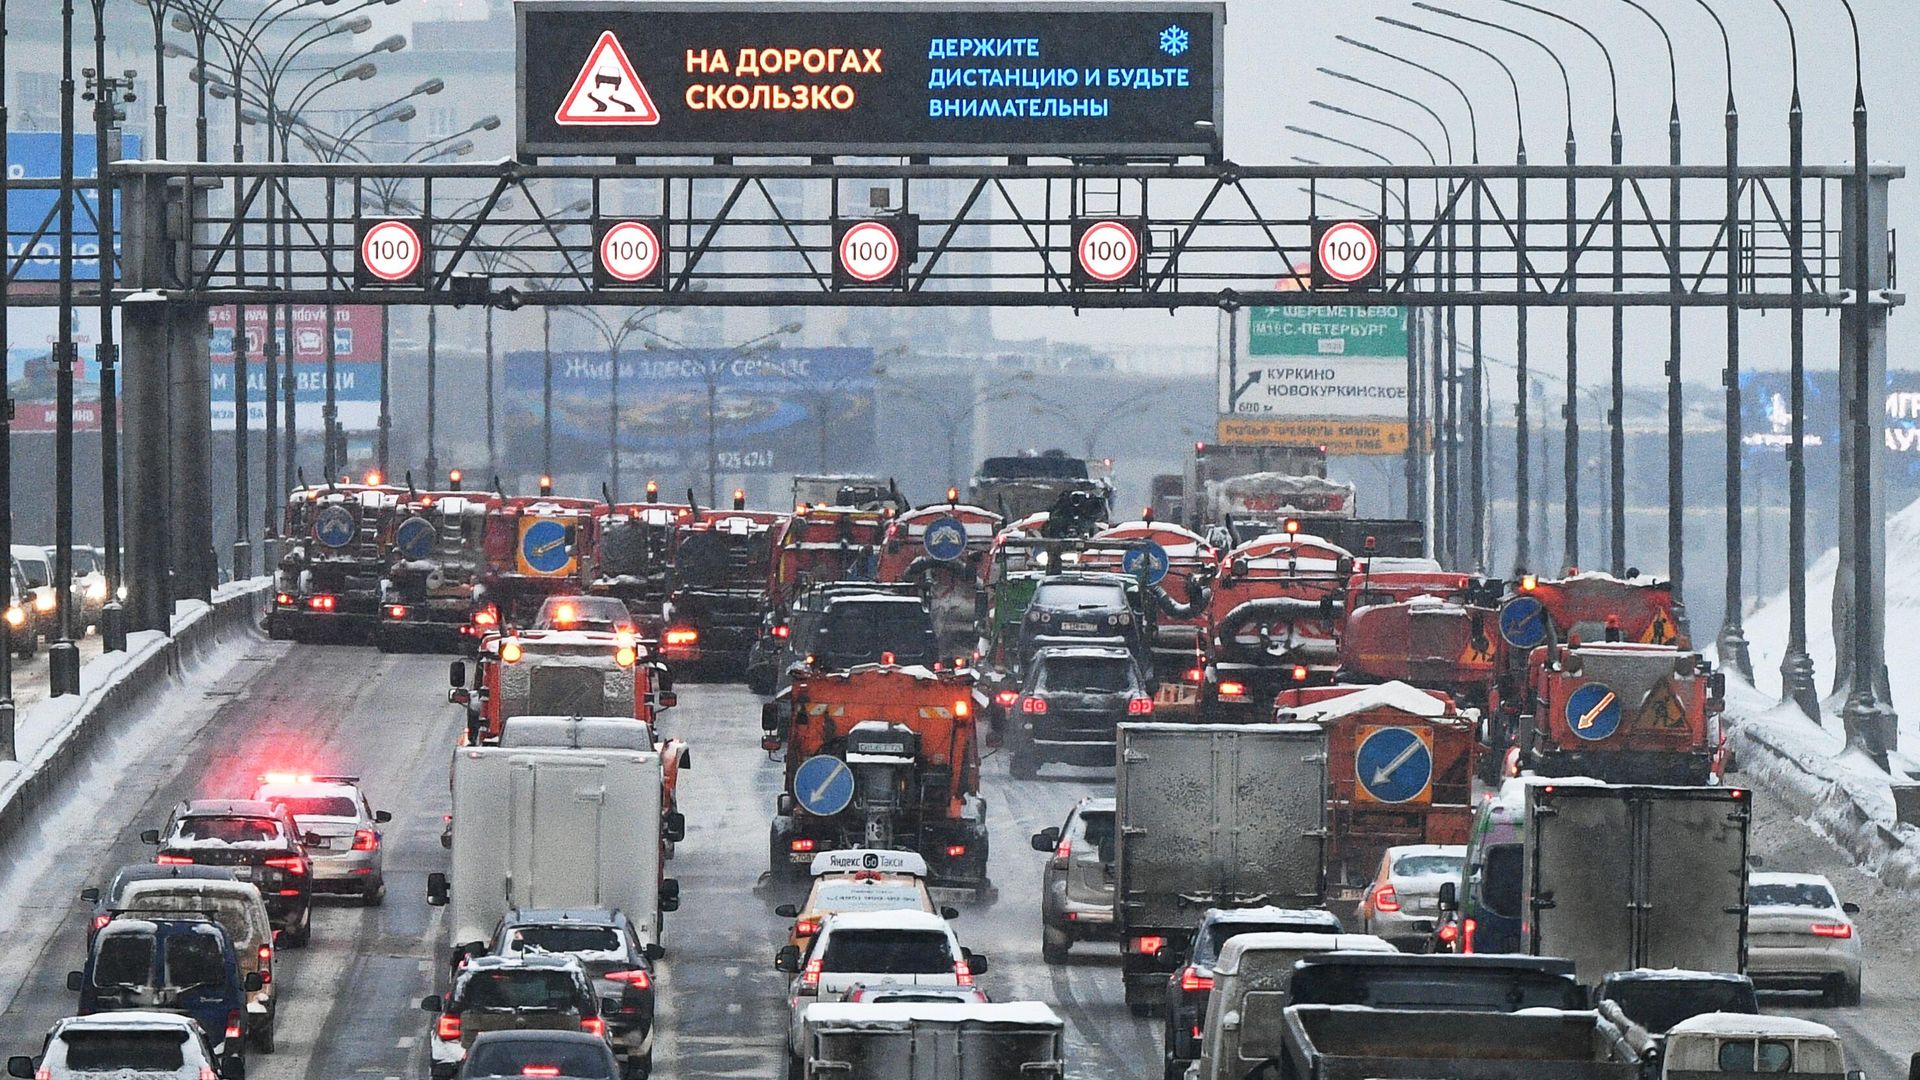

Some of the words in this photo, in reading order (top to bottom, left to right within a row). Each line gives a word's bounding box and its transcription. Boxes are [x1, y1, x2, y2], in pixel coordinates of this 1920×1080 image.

[927, 37, 1040, 61] ДЕРЖИТЕ
[686, 48, 731, 75] НА
[734, 47, 883, 78] ДОРОГАХ
[927, 67, 1081, 91] ДИСТАНЦИЮ
[1084, 67, 1104, 88] И
[1107, 67, 1190, 91] БУДЬТЕ
[685, 83, 855, 112] СКОЛЬЗКО
[929, 96, 1109, 119] ВНИМАТЕЛЬНЫ
[373, 240, 409, 260] 100
[612, 241, 648, 261] 100
[850, 242, 888, 261] 100
[1089, 241, 1126, 261] 100
[1329, 241, 1366, 261] 100
[1283, 306, 1399, 318] ШЕРЕМЕТЬЕВО
[1267, 368, 1336, 382] КУРКИНО
[1267, 384, 1407, 399] НОВОКУРКИНСКОЕ
[829, 855, 861, 868] Яндекс
[864, 854, 878, 868] Go
[881, 856, 904, 868] Такси
